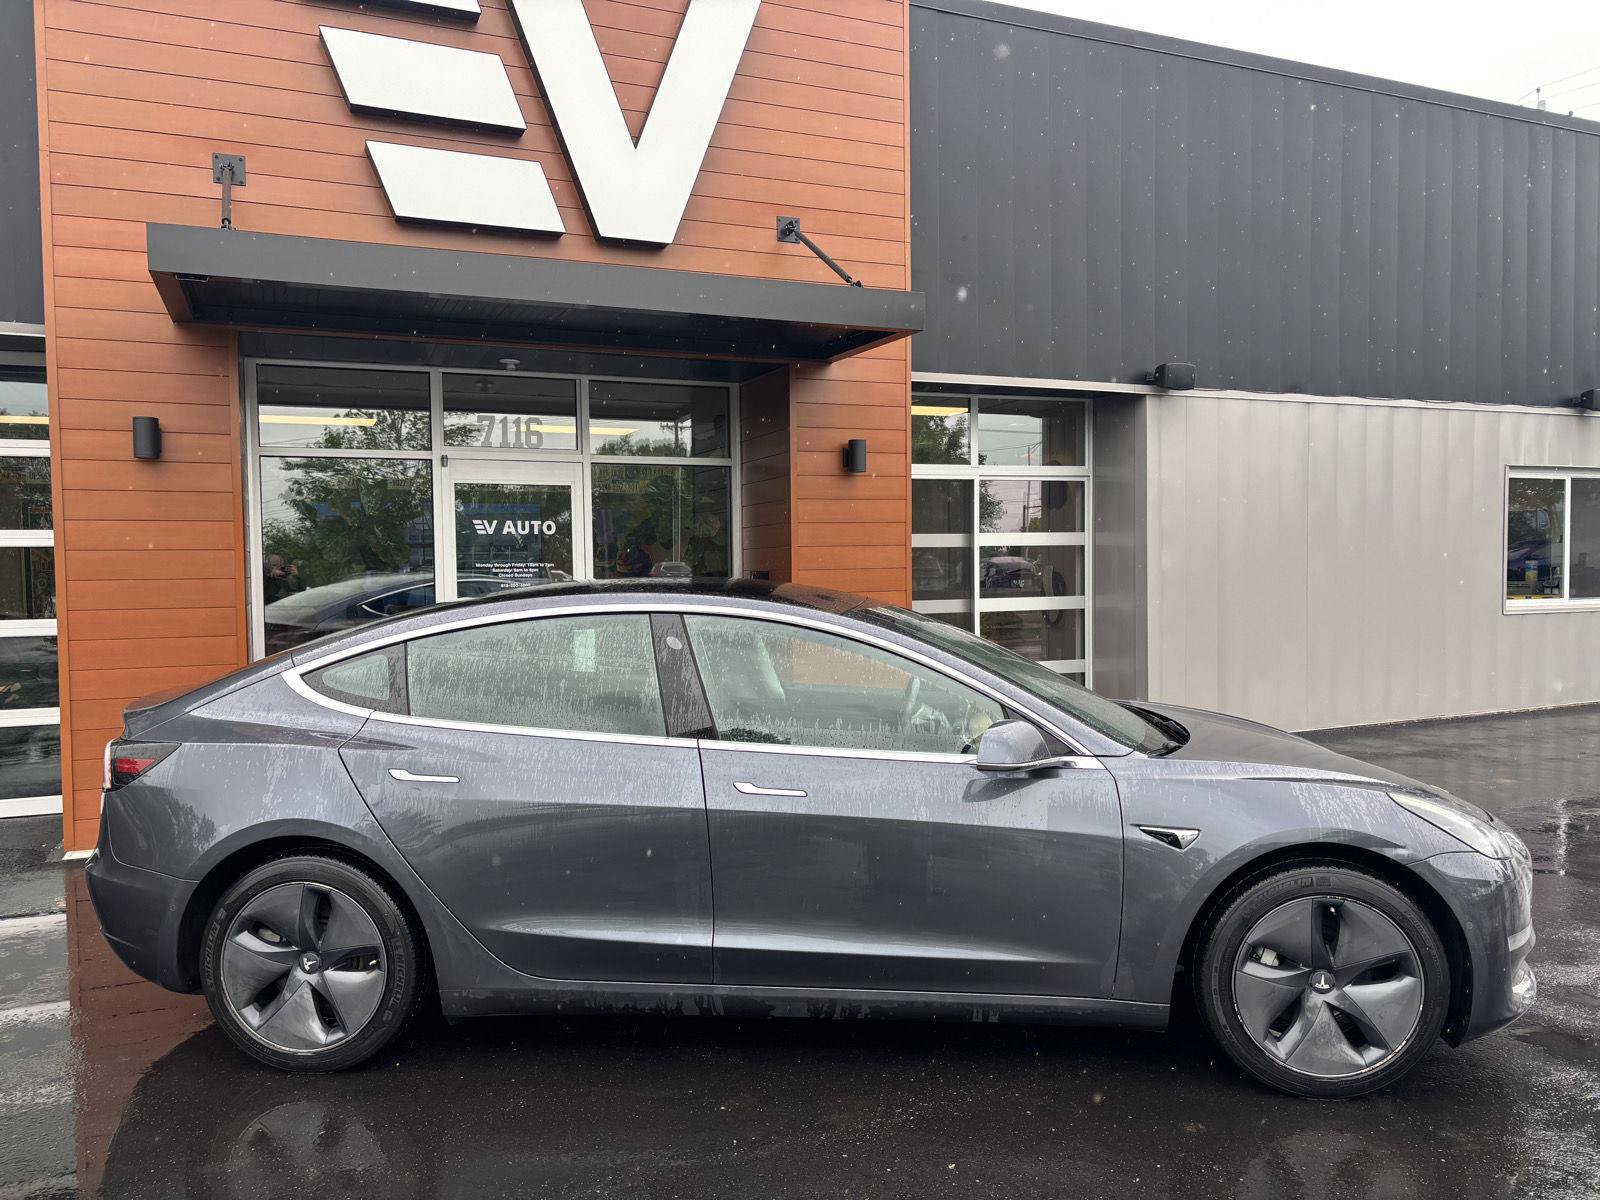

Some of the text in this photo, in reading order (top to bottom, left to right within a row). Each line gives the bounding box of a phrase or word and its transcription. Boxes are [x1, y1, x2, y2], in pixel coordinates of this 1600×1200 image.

[477, 415, 544, 449] 7116
[472, 519, 557, 535] EV AUTO
